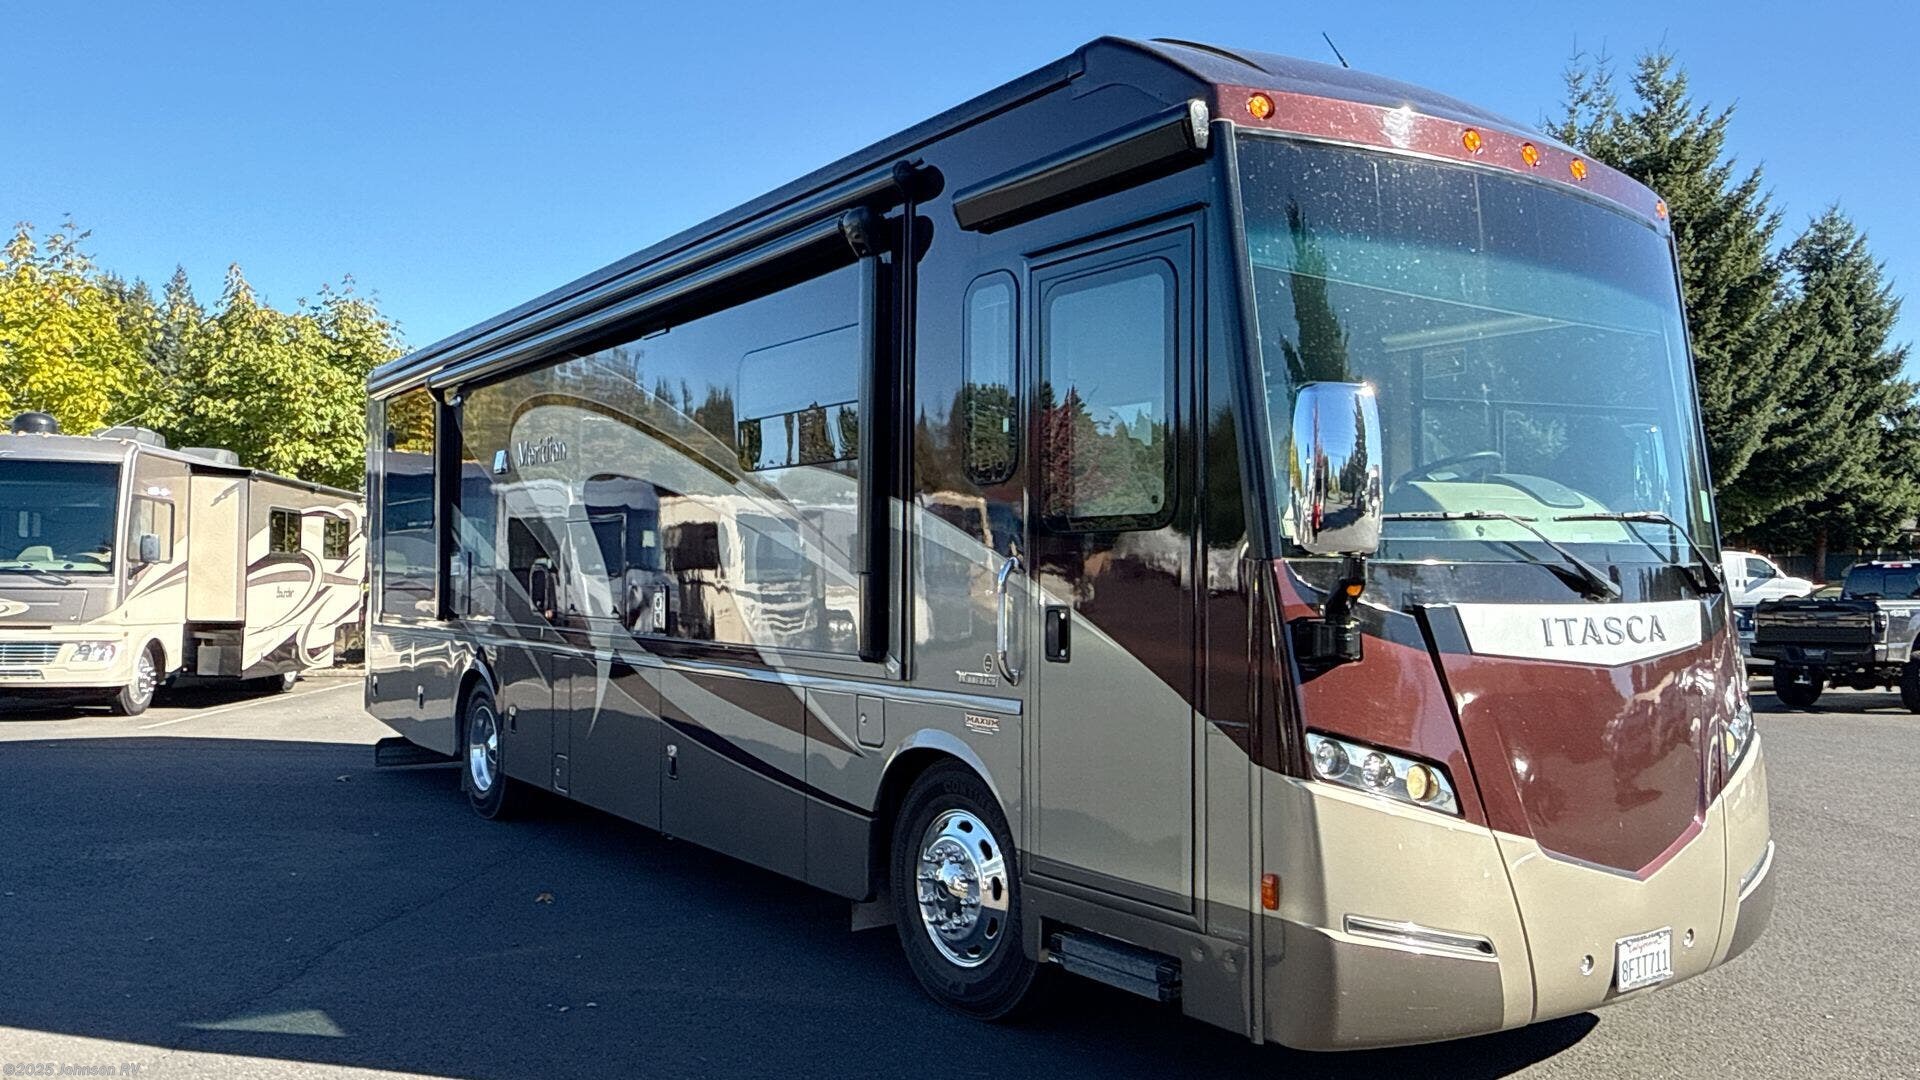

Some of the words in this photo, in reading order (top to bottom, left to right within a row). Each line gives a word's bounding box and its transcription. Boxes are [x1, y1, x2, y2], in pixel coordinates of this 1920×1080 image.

[1541, 615, 1667, 647] ITASCA
[966, 714, 1000, 727] MAXUM
[1622, 949, 1668, 982] 8FIT711
